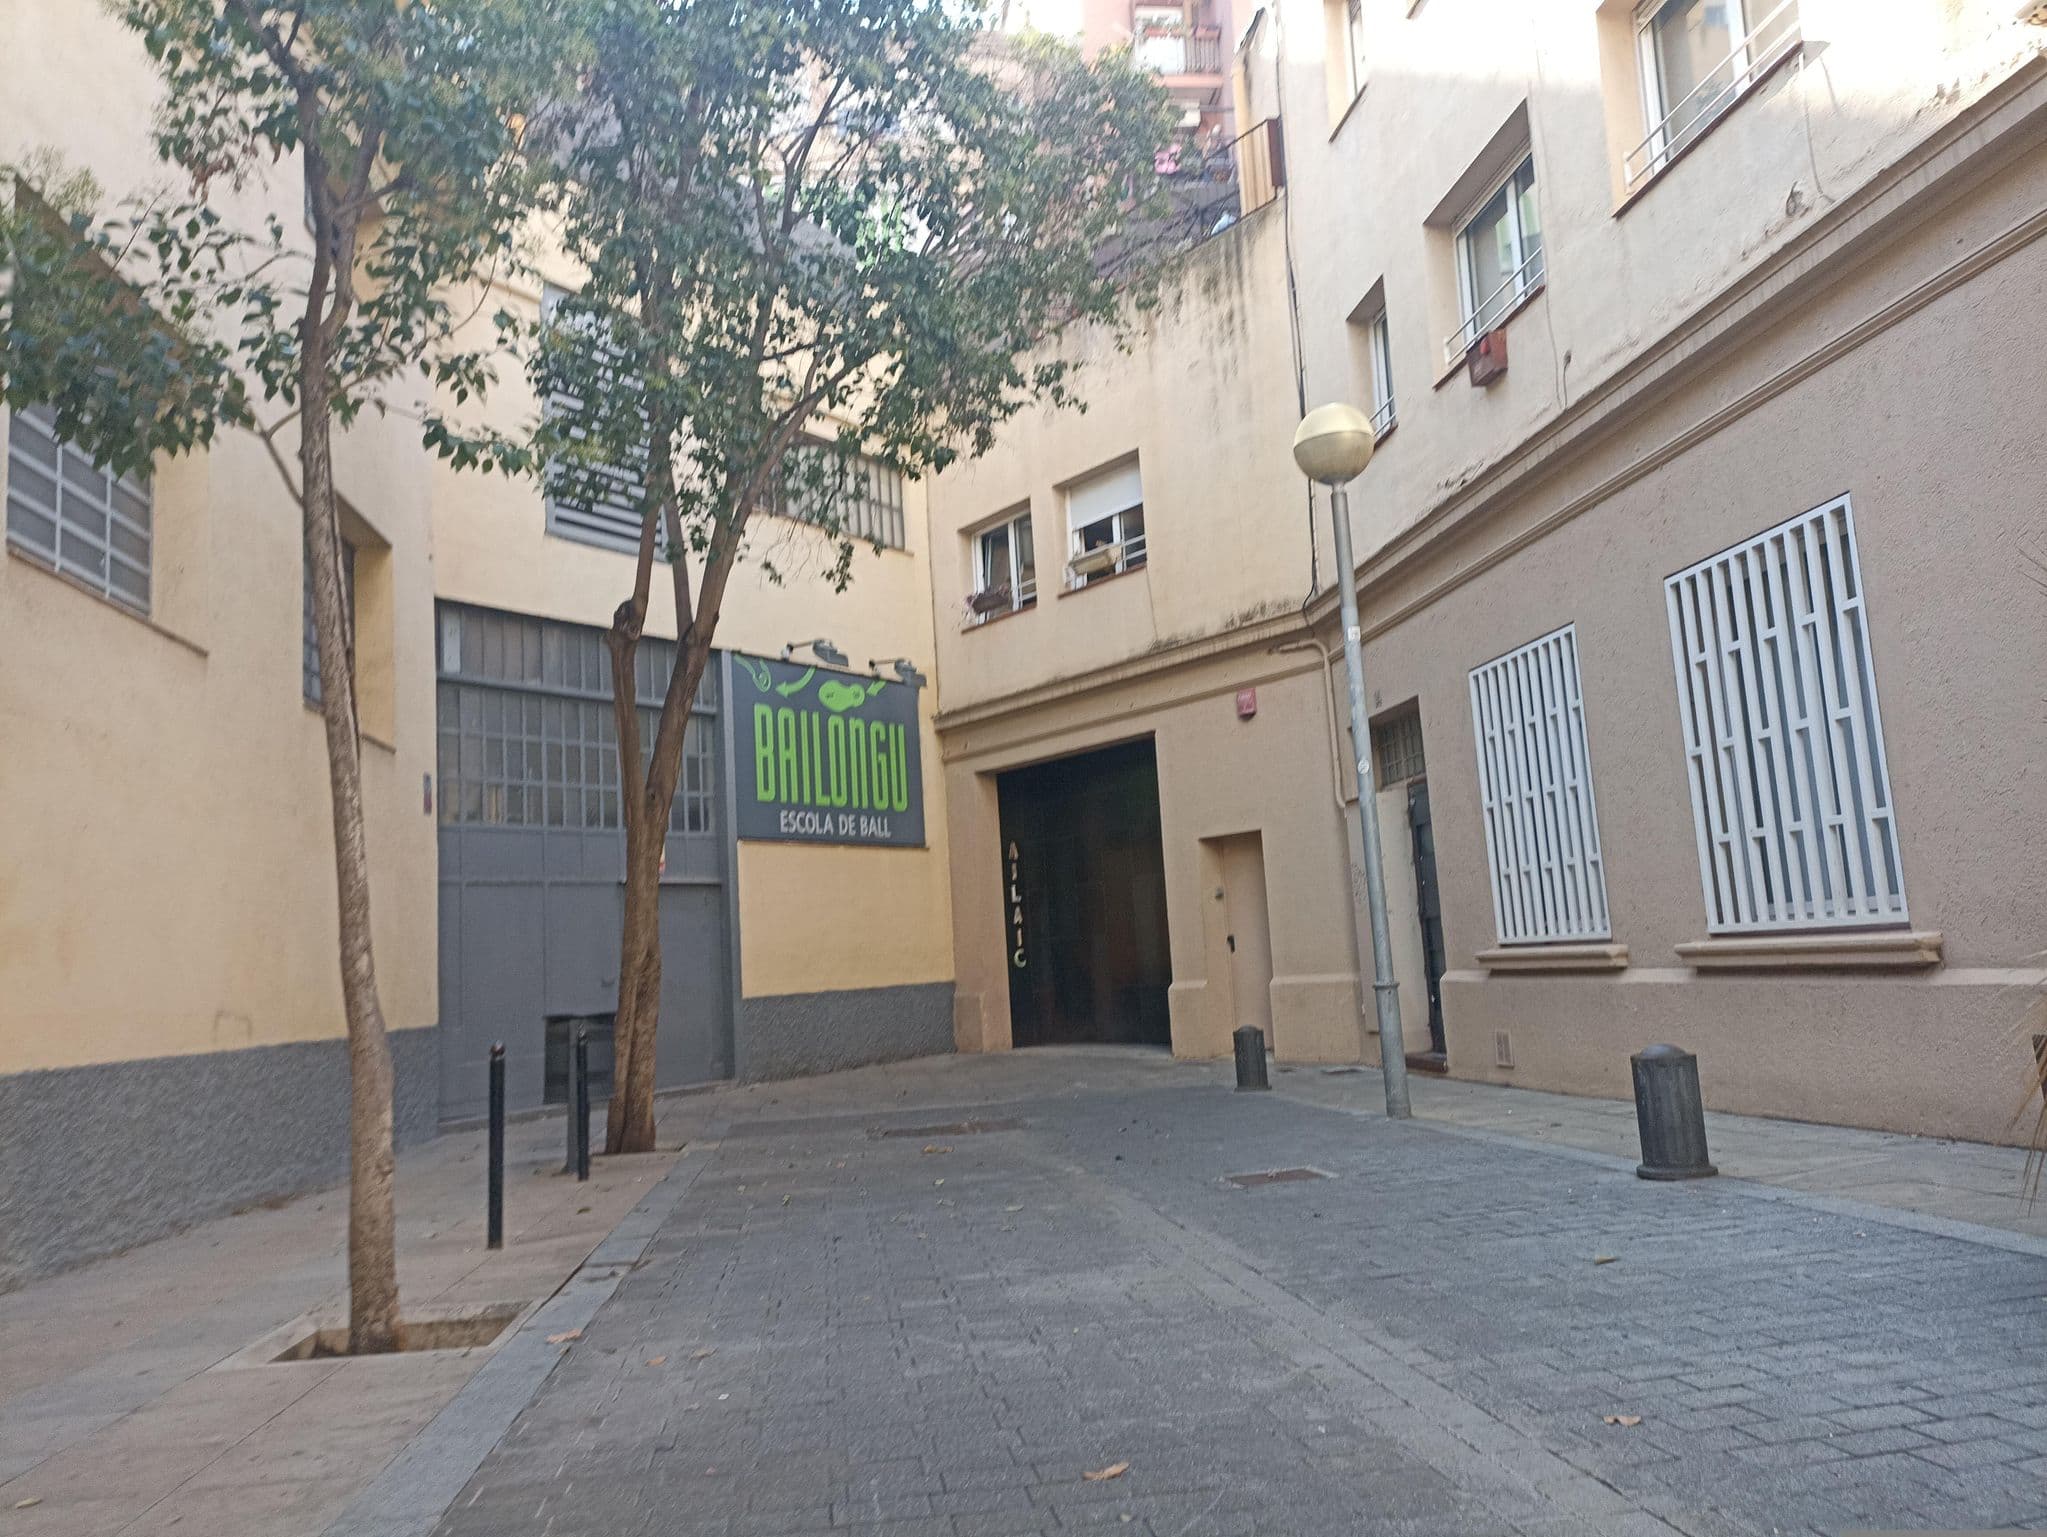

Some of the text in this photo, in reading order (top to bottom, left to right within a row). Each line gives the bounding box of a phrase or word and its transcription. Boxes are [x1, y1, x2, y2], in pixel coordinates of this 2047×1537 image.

[754, 703, 908, 812] BAILONGU
[780, 811, 892, 838] ESCOLA DE BALL
